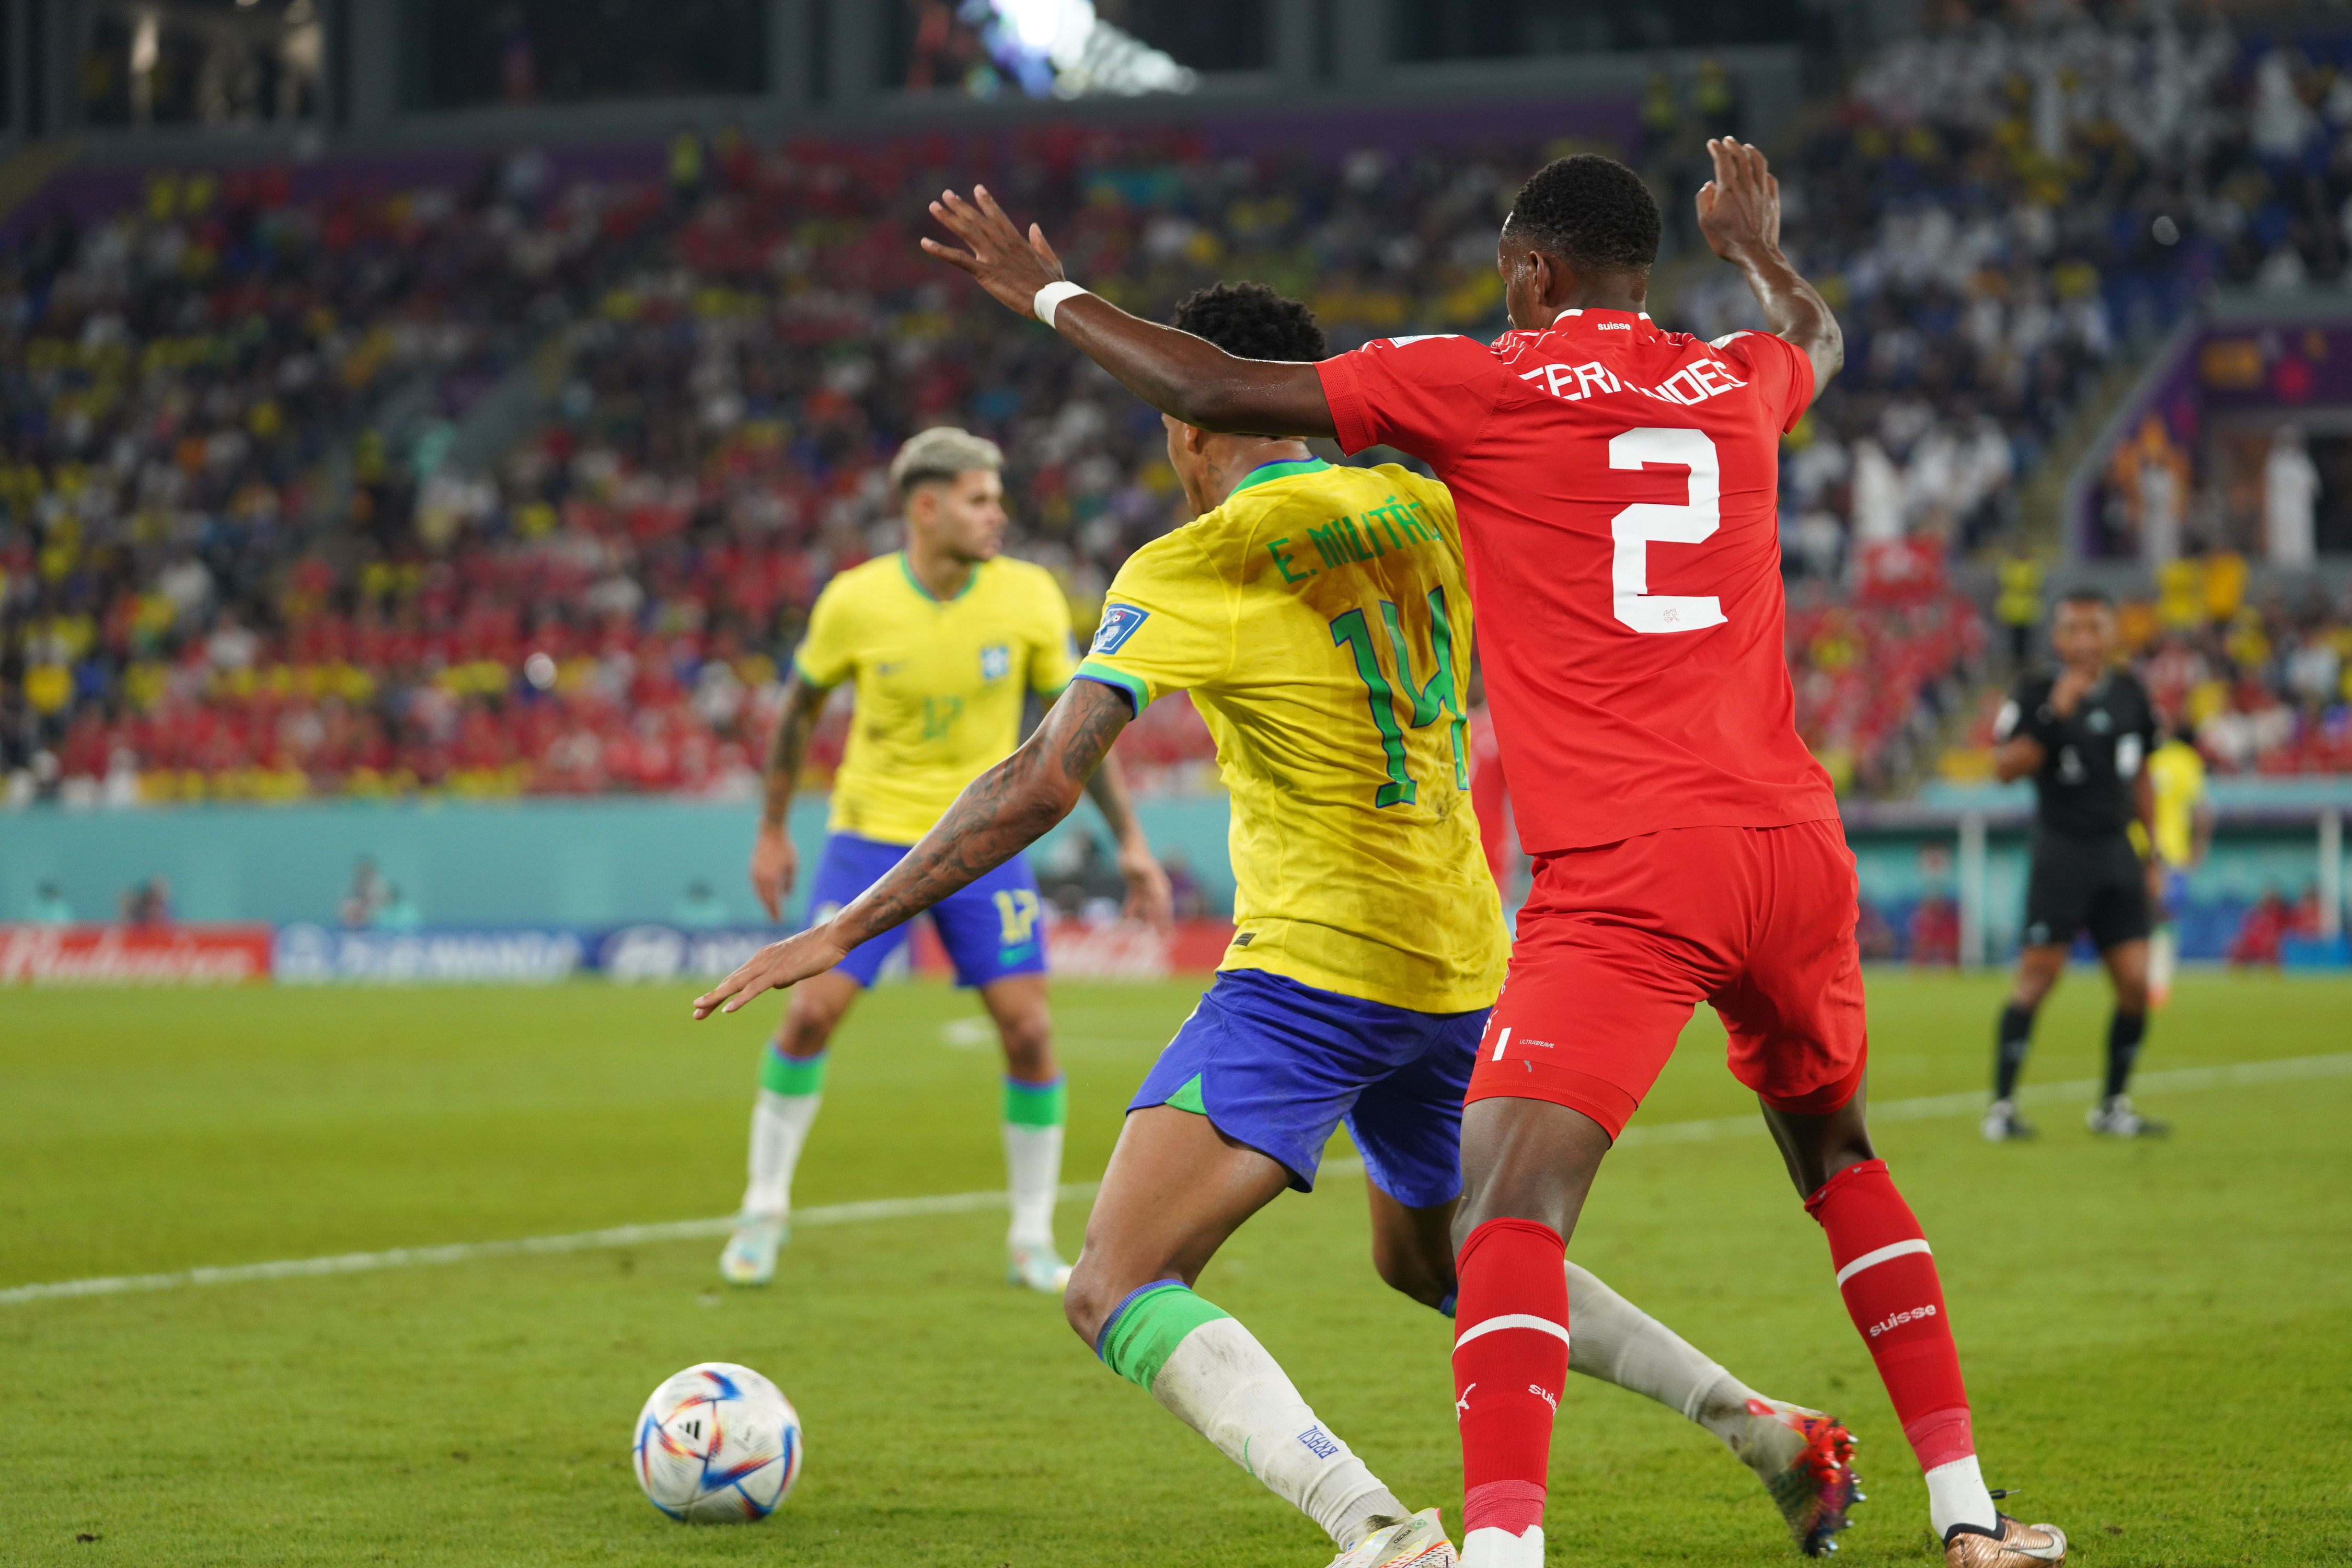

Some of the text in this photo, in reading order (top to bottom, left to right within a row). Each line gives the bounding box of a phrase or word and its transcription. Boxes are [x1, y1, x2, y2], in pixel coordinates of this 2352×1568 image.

[1597, 321, 1631, 330] suisse
[1609, 427, 1728, 633] 2
[1329, 574, 1470, 809] 14
[921, 695, 964, 741] 17
[993, 888, 1039, 945] 17
[1519, 1039, 1554, 1048] ULTRAWEAVE
[1870, 1304, 1936, 1337] suisse
[1297, 1425, 1339, 1459] BRASIL
[1393, 1529, 1412, 1543] CECILIA
